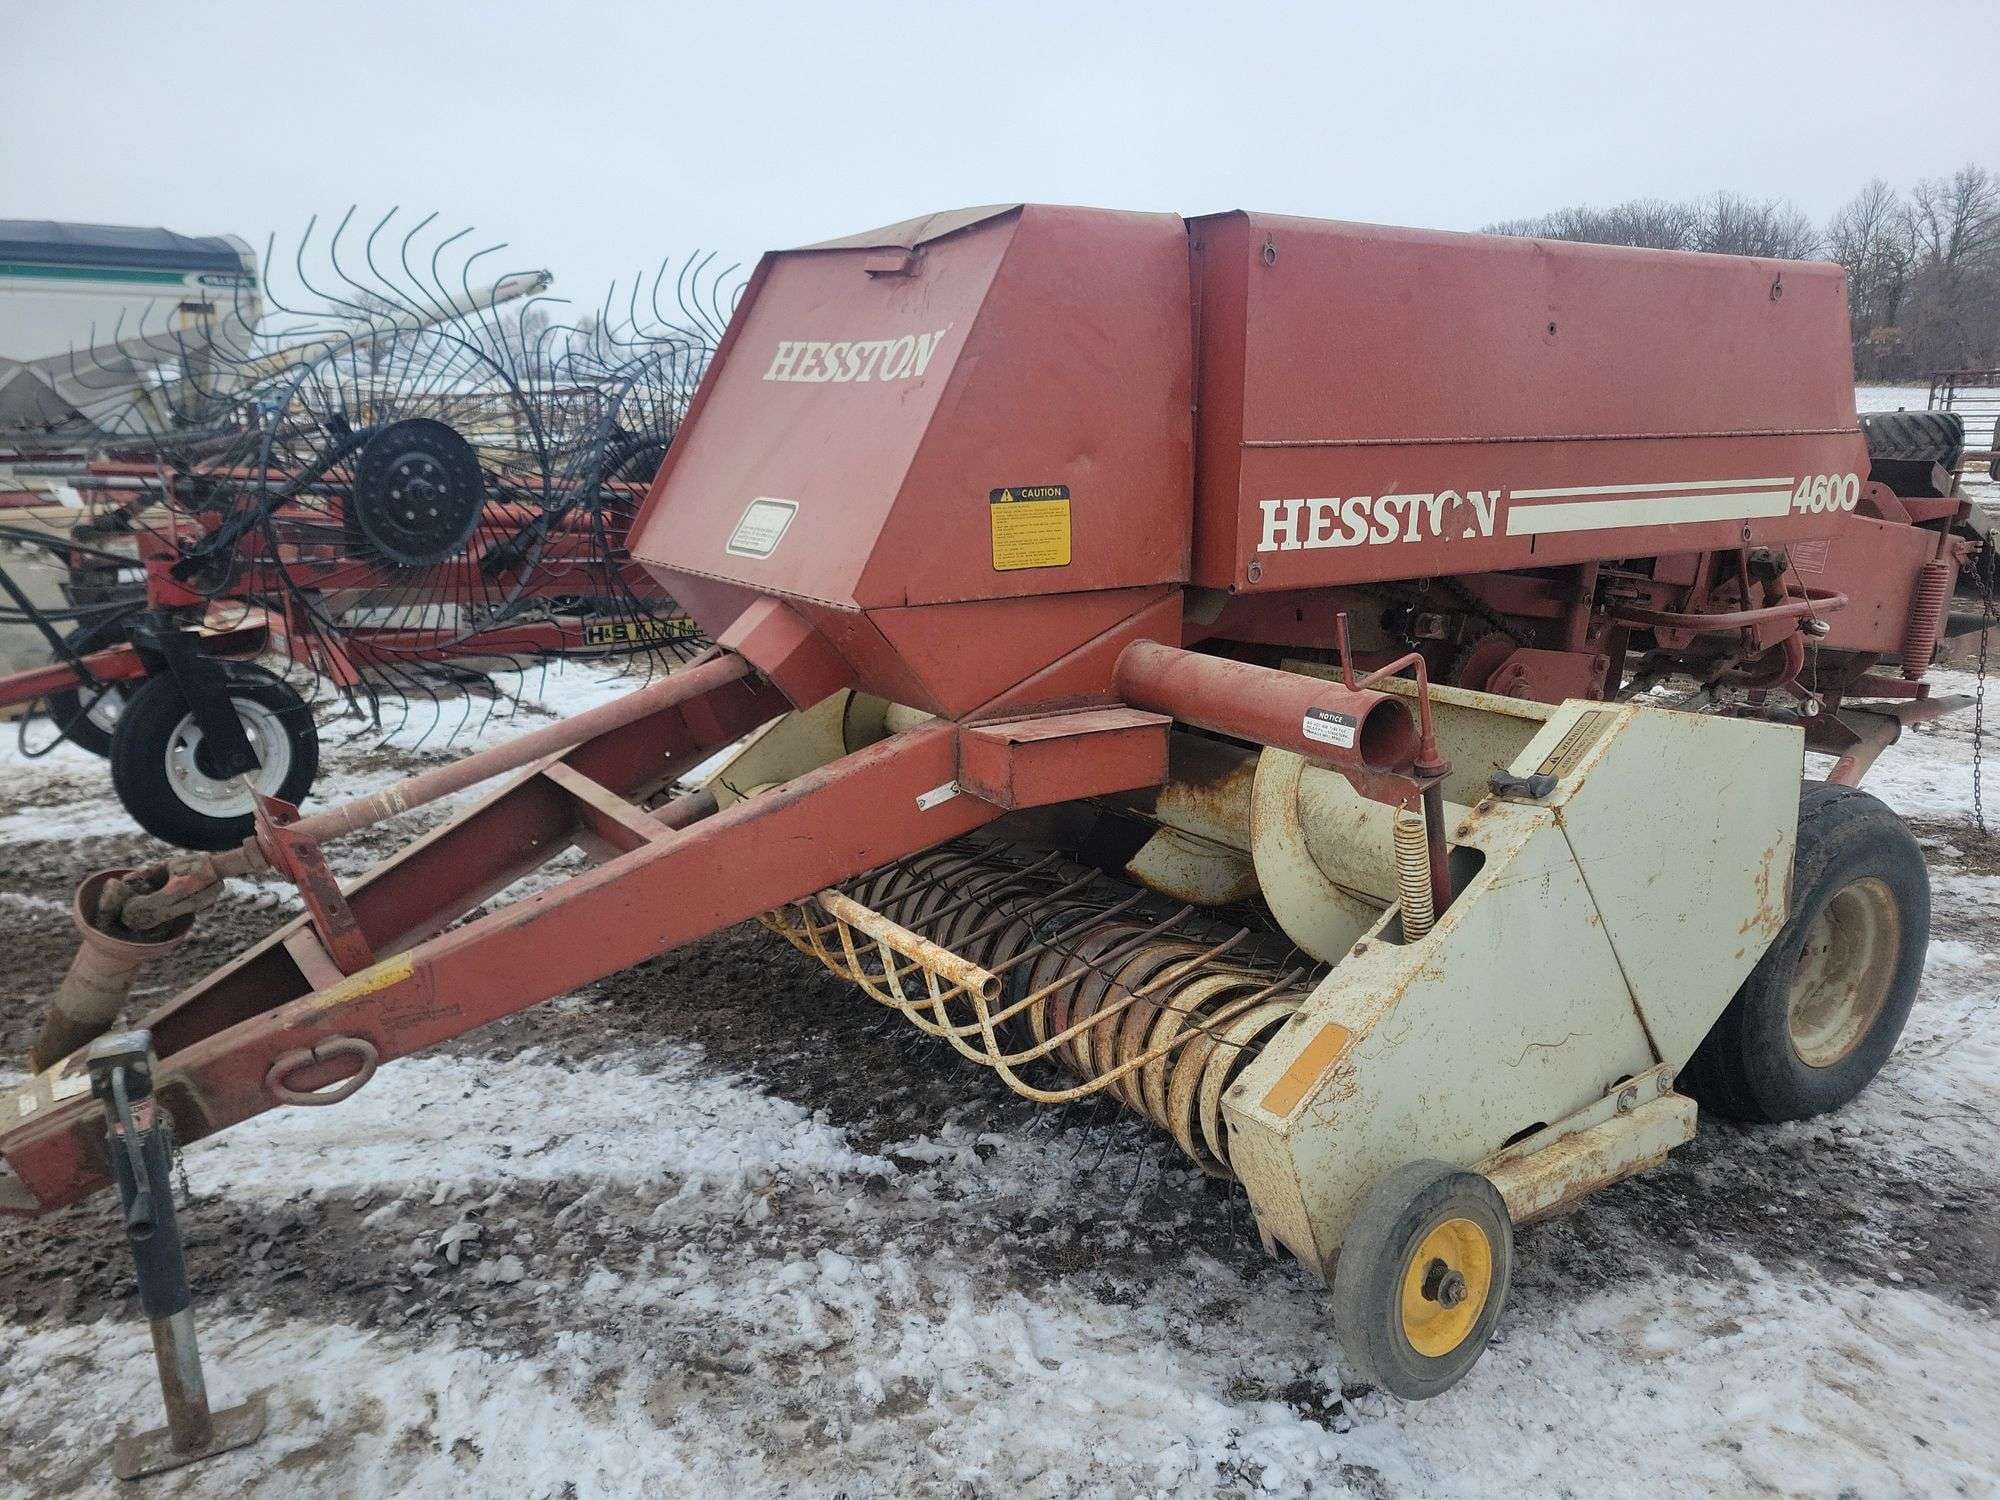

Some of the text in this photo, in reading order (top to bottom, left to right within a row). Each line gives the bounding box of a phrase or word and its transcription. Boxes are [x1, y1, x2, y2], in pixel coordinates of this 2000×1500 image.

[762, 330, 946, 382] HESSTON
[1021, 488, 1061, 498] CAUTION
[1792, 473, 1860, 513] 4600
[1319, 712, 1343, 722] NOTICE
